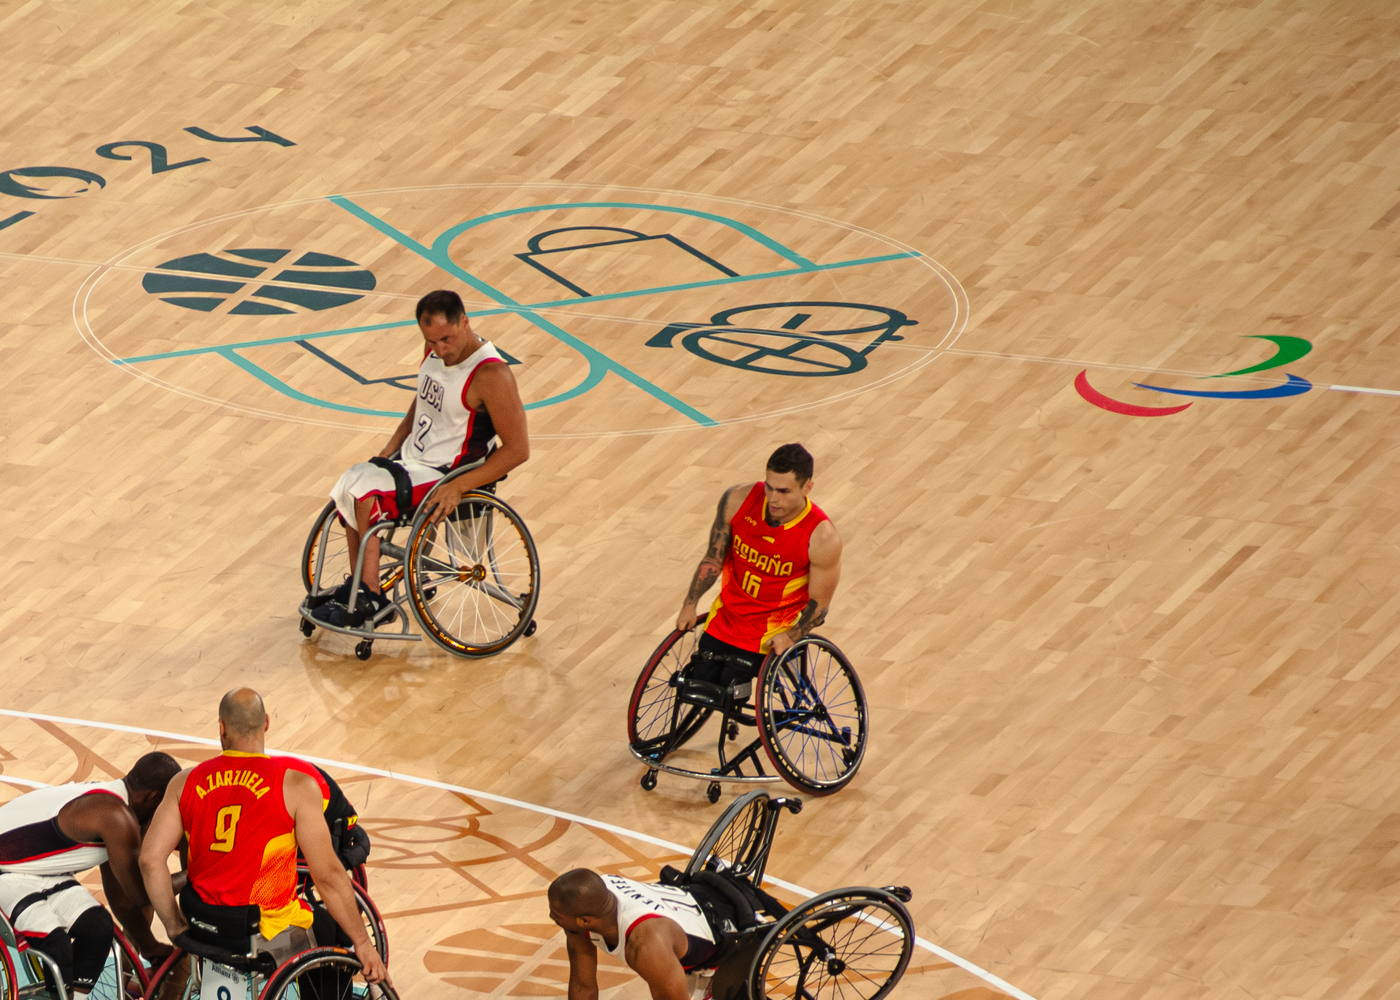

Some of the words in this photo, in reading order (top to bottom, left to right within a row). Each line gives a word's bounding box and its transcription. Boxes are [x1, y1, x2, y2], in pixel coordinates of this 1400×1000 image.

[420, 374, 445, 413] USA
[413, 413, 433, 453] 2
[733, 534, 794, 577] ESPAÑA
[741, 570, 763, 599] 16
[195, 769, 271, 800] A.ZARZUELA
[208, 803, 243, 853] 9
